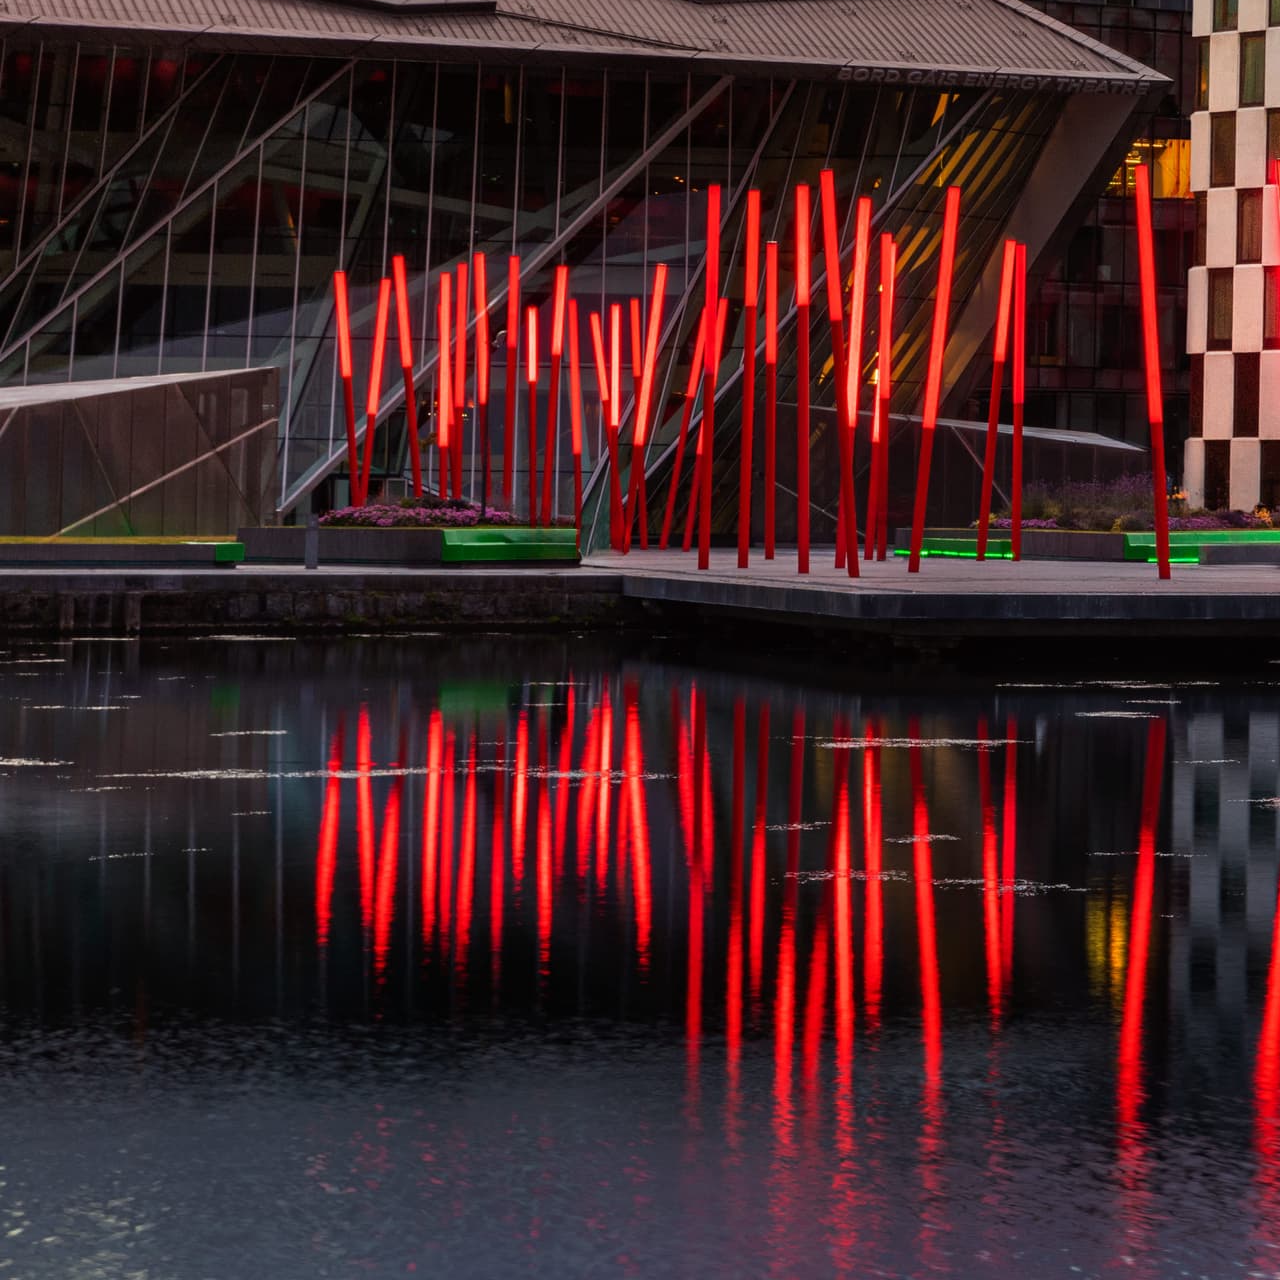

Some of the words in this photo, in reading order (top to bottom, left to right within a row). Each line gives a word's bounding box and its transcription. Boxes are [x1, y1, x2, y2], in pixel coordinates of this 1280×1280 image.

[838, 67, 900, 82] BORD
[963, 72, 1050, 91] ENERGY
[1056, 77, 1150, 96] THEATRE
